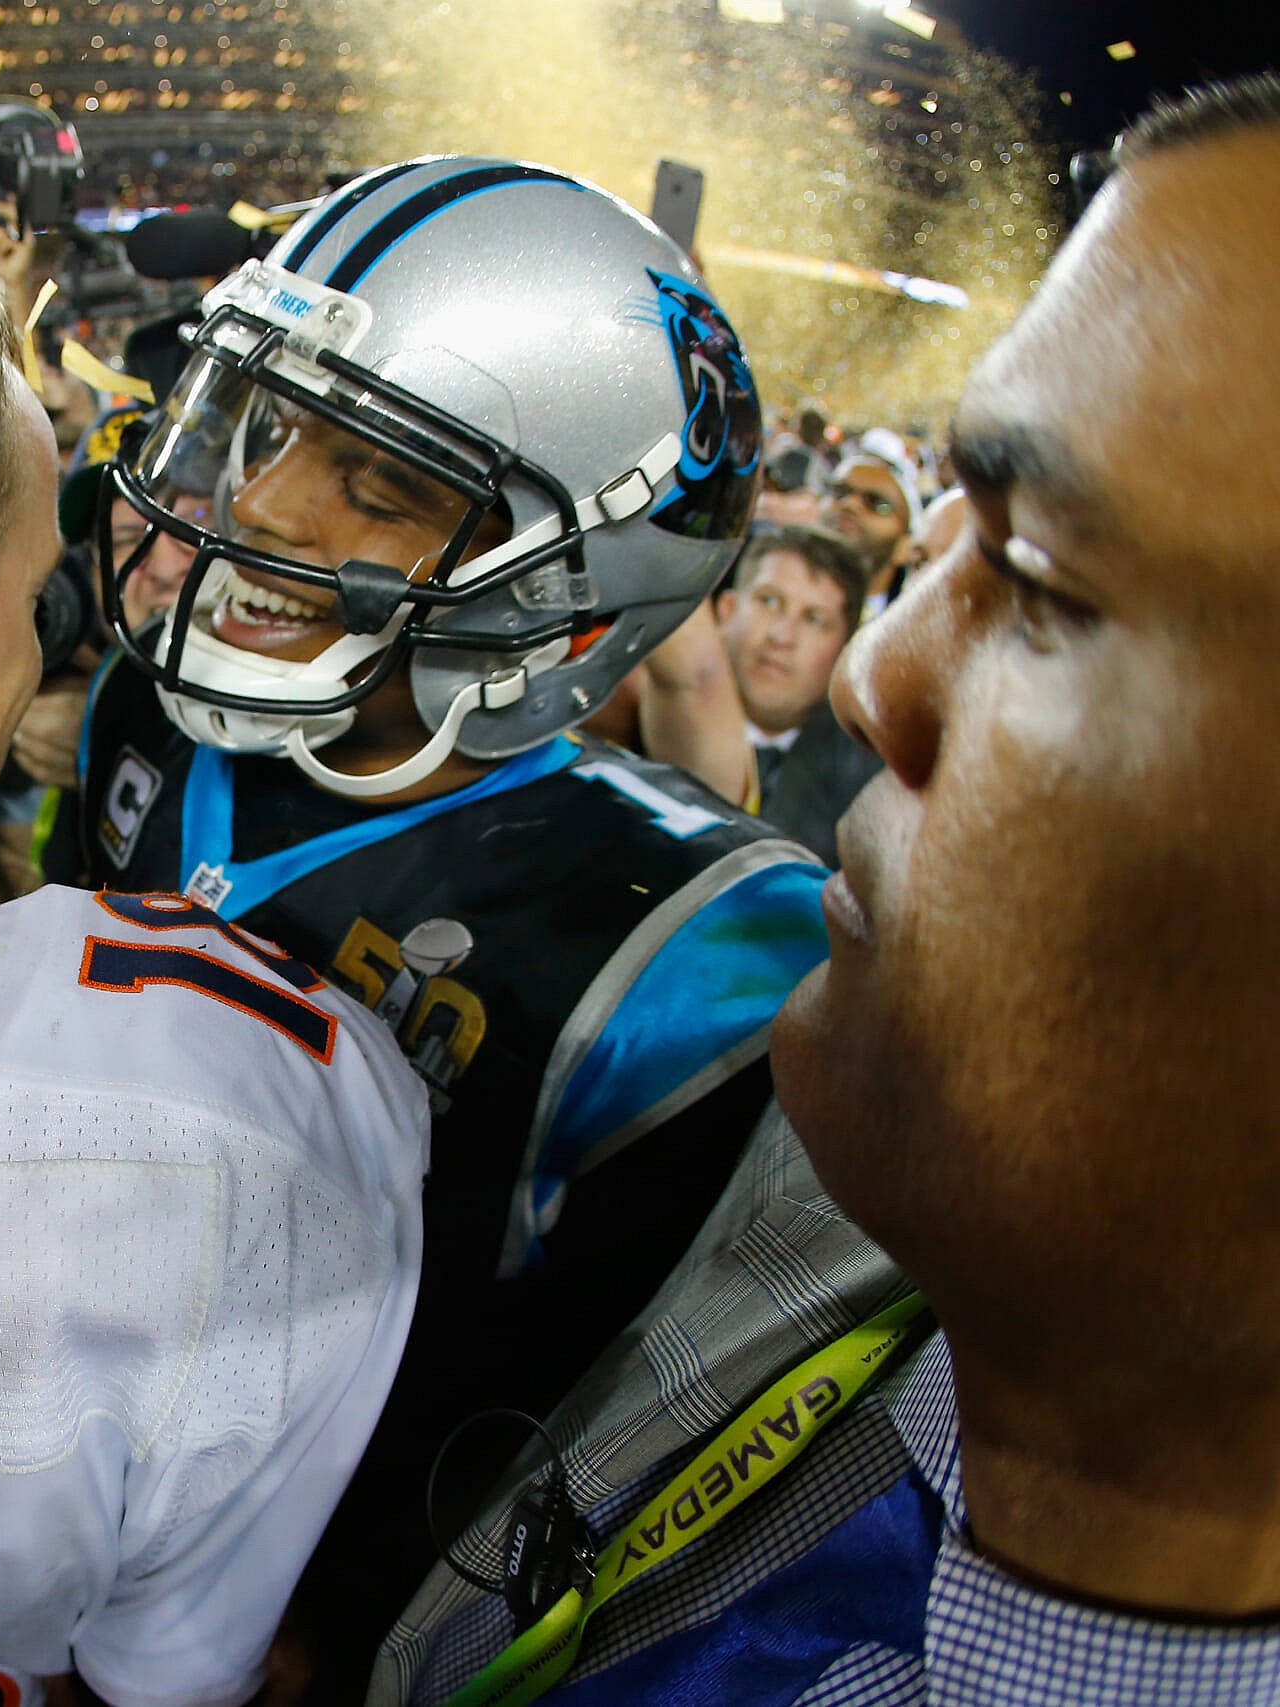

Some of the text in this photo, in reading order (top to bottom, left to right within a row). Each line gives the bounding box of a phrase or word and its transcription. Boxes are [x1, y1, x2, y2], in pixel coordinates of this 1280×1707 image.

[569, 760, 726, 841] 1
[616, 1376, 842, 1578] GAMEDAY
[508, 1523, 527, 1577] OTTO
